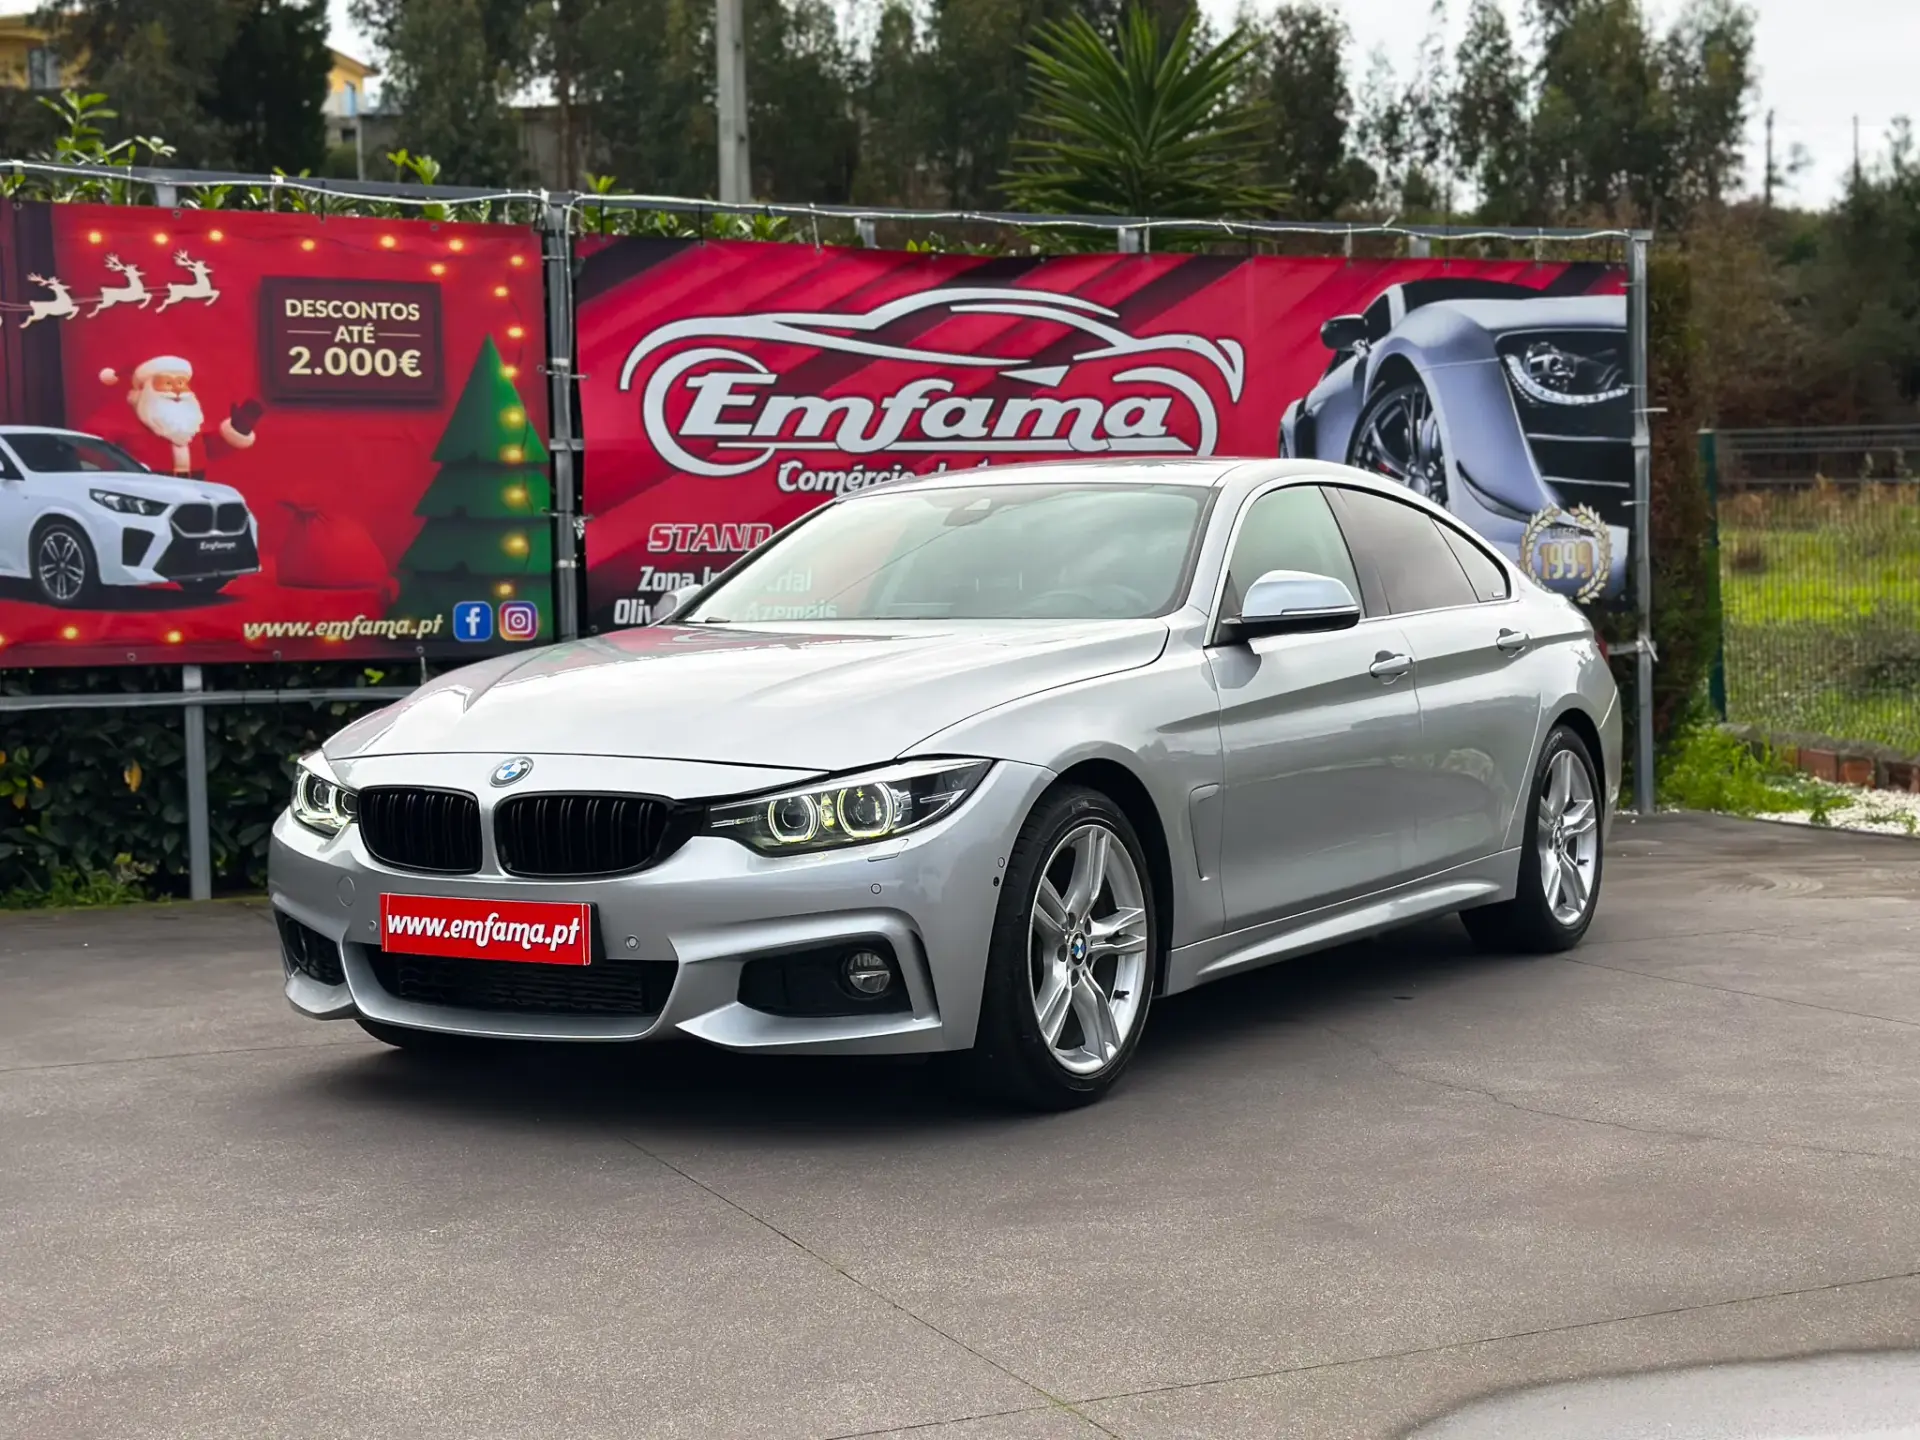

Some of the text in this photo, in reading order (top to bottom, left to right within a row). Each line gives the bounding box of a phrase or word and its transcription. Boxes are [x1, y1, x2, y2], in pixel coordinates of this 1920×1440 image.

[285, 299, 420, 321] DESCONTOS
[334, 323, 376, 344] ATÉ
[288, 346, 422, 377] 2.000€
[679, 371, 1174, 453] Emfama
[647, 523, 774, 552] STAND
[1539, 541, 1593, 580] 1999
[637, 565, 695, 592] Zona
[243, 614, 443, 641] www.emfama.pt
[387, 912, 580, 952] www.emfama.pt
